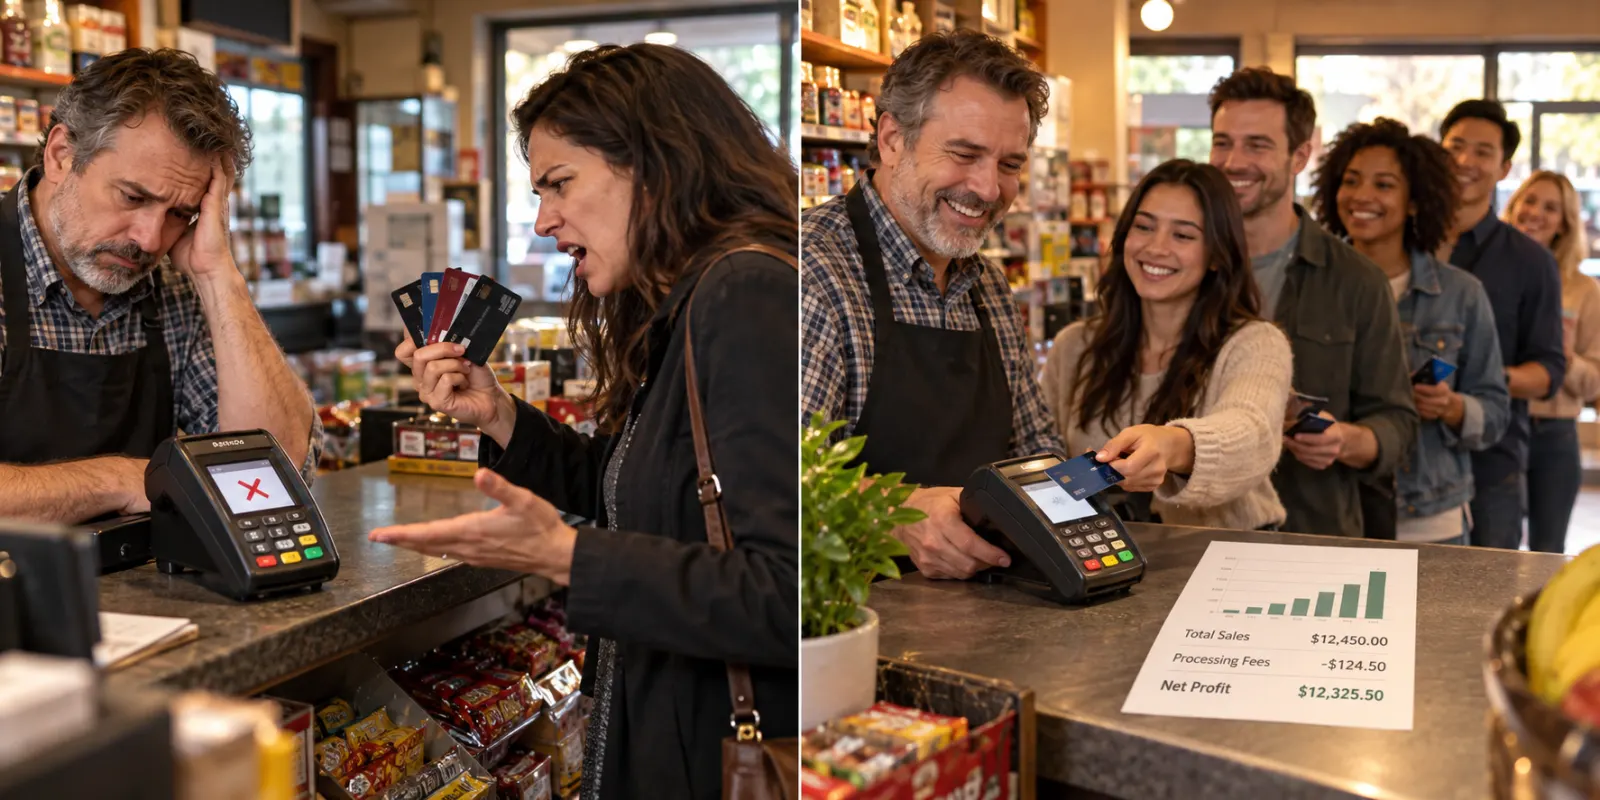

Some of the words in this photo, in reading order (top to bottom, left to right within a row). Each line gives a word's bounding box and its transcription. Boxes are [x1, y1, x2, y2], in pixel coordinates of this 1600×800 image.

[1185, 628, 1215, 640] Total
[1217, 630, 1250, 642] Sales
[1310, 633, 1389, 647] $12,450.00
[1172, 652, 1239, 668] Processing
[1241, 656, 1271, 667] Fees
[1321, 659, 1387, 672] -$124.50
[1160, 680, 1188, 693] Net
[1190, 681, 1232, 695] Profit
[1298, 685, 1385, 702] $12,325.50
